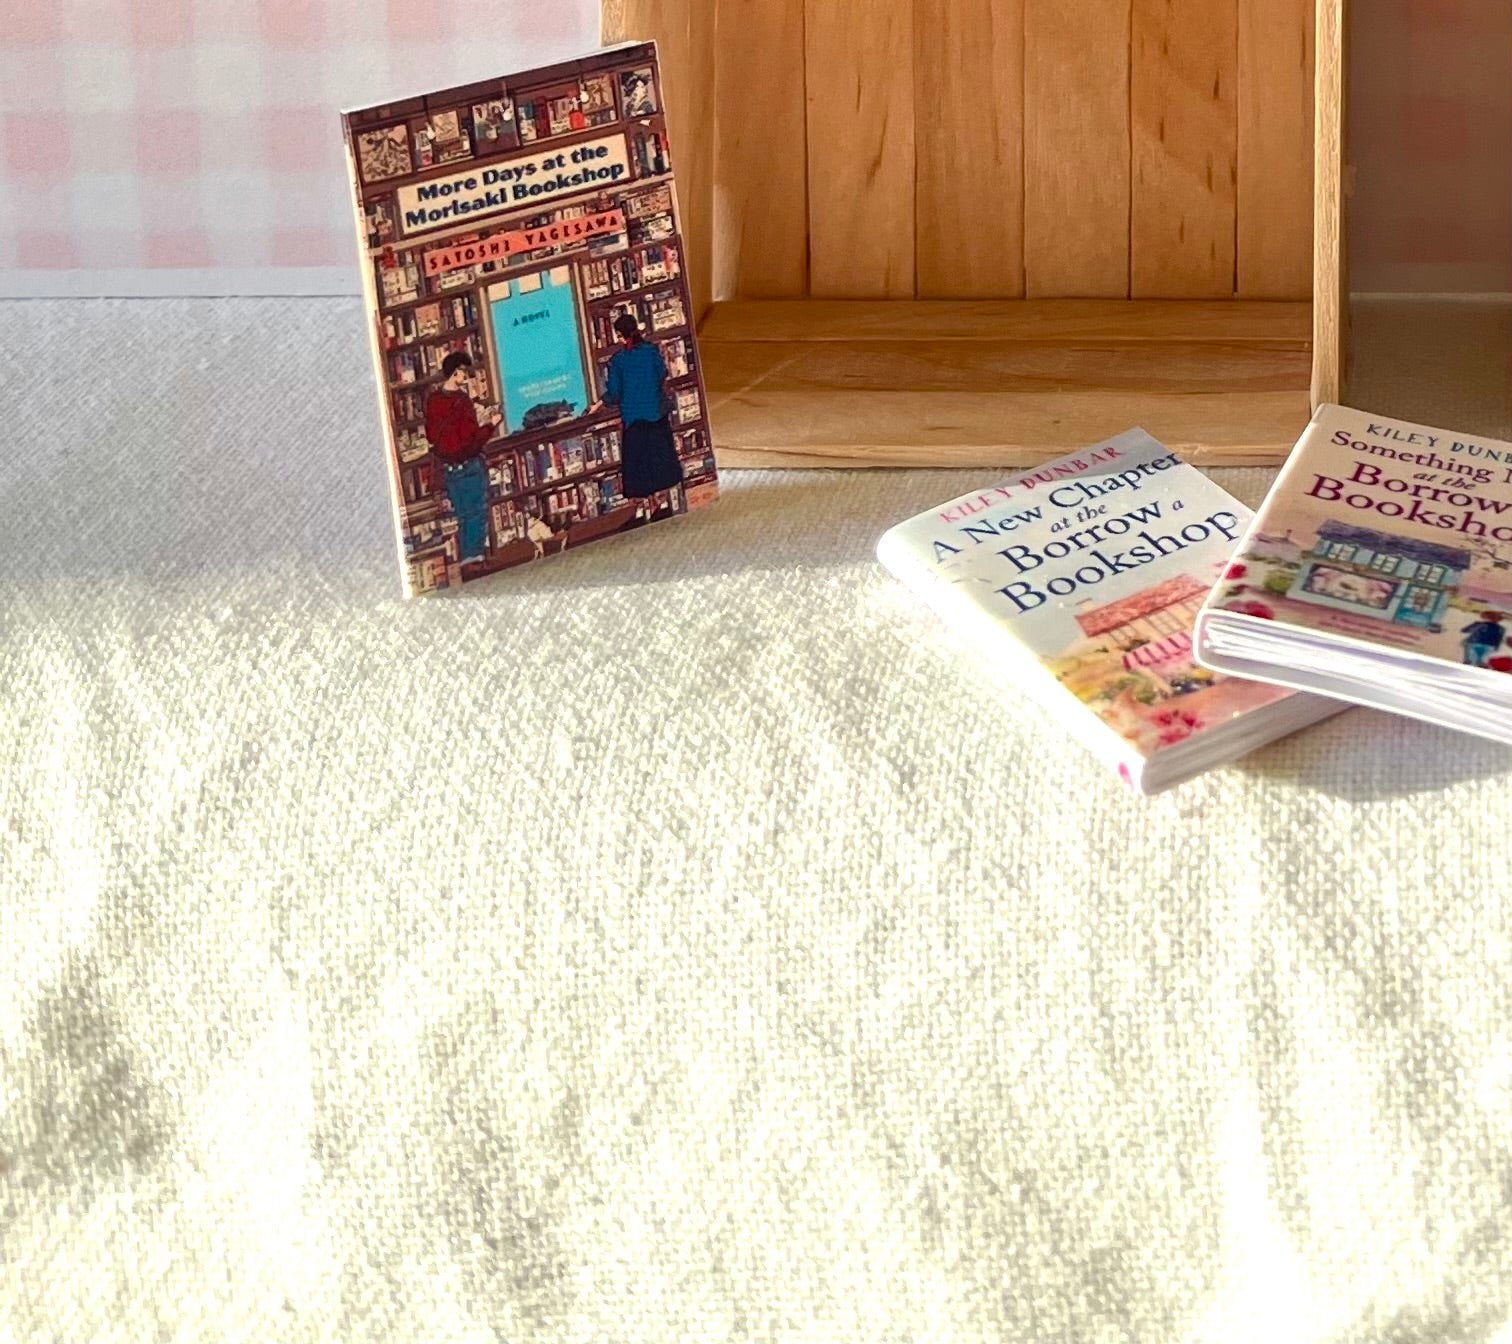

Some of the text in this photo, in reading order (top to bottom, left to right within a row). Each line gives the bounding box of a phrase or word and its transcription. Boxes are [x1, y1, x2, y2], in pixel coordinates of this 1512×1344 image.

[406, 162, 625, 228] Morisaki Bookshop
[417, 144, 608, 202] More Days at the
[429, 238, 510, 271] SATOSHI
[1331, 430, 1495, 484] Something
[1366, 423, 1439, 448] KILEY
[931, 452, 1184, 564] A New Chapter
[939, 445, 1124, 524] KILEY DUNBAR
[1413, 470, 1477, 491] at the
[996, 499, 1185, 574] Borrow a
[1050, 503, 1108, 534] at the
[995, 510, 1239, 614] Bookshop
